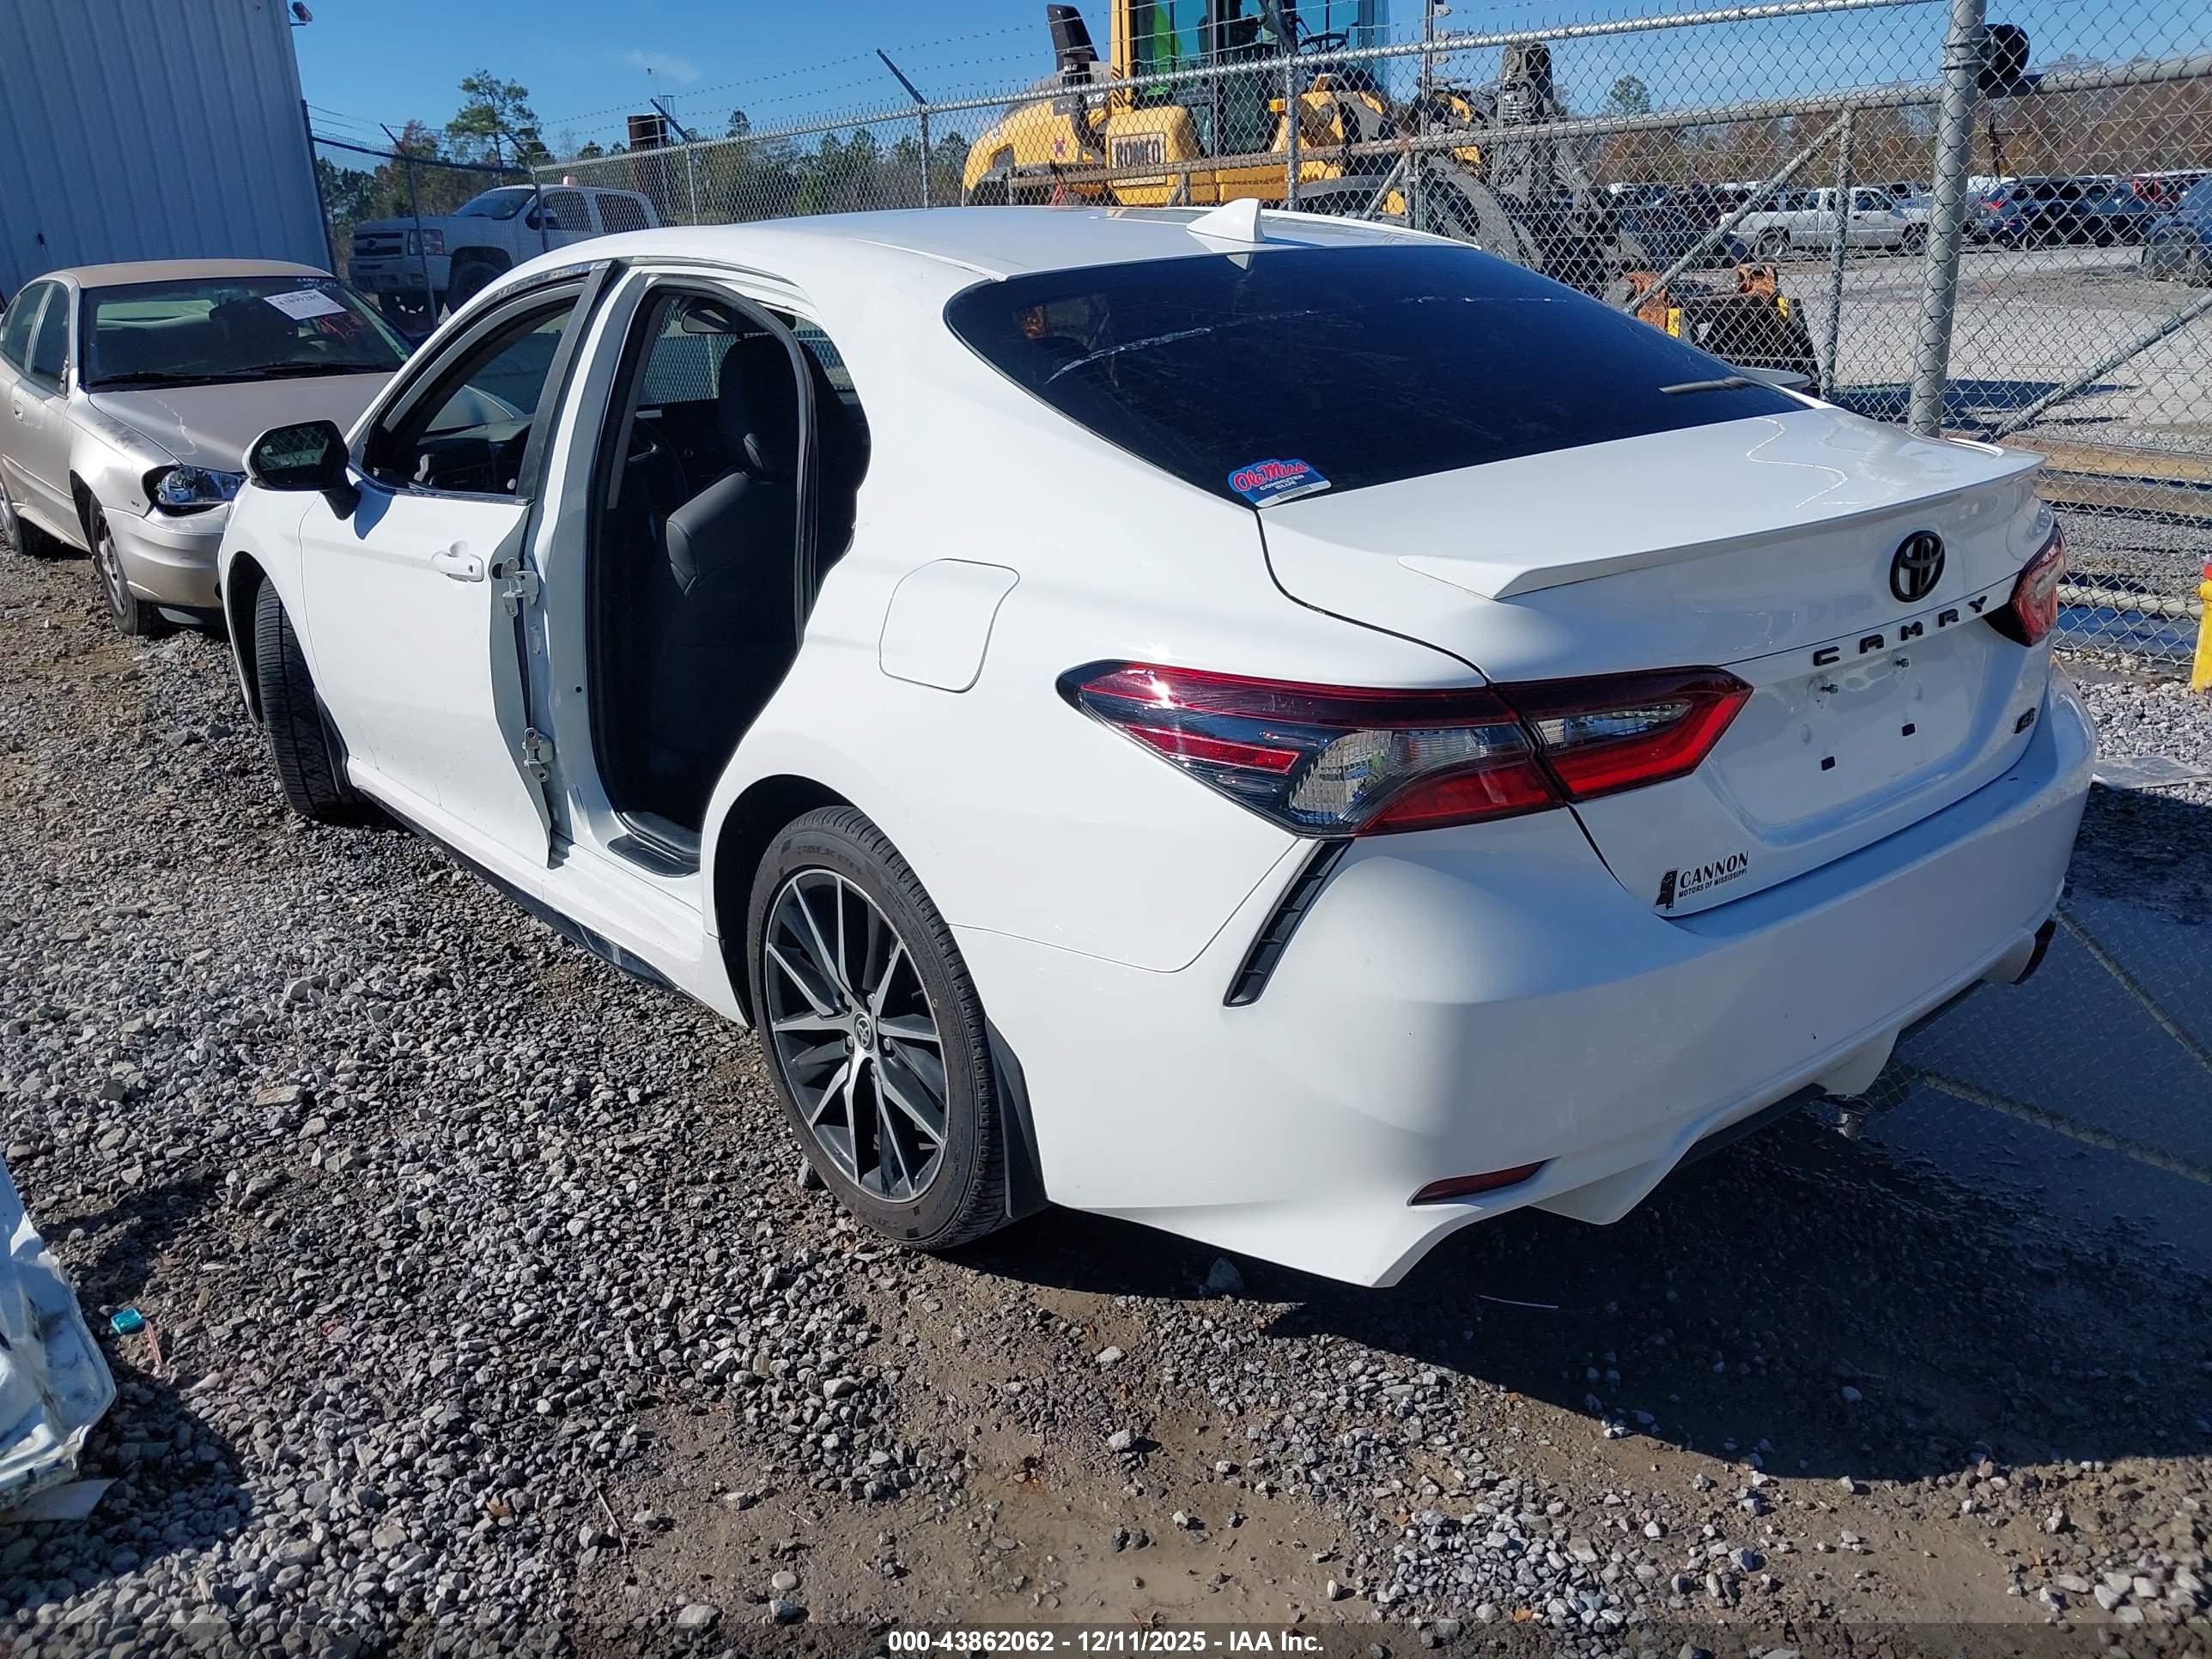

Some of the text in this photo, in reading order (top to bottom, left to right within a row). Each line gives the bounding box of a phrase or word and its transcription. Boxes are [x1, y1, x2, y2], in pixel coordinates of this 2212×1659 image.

[1234, 462, 1309, 491] Ole Miss
[1259, 475, 1305, 490] COMMUTER
[1813, 595, 1988, 666] CAMRY
[1678, 867, 1747, 898] MOTORS OF MISSISSIPPI
[1680, 850, 1749, 889] CANNON
